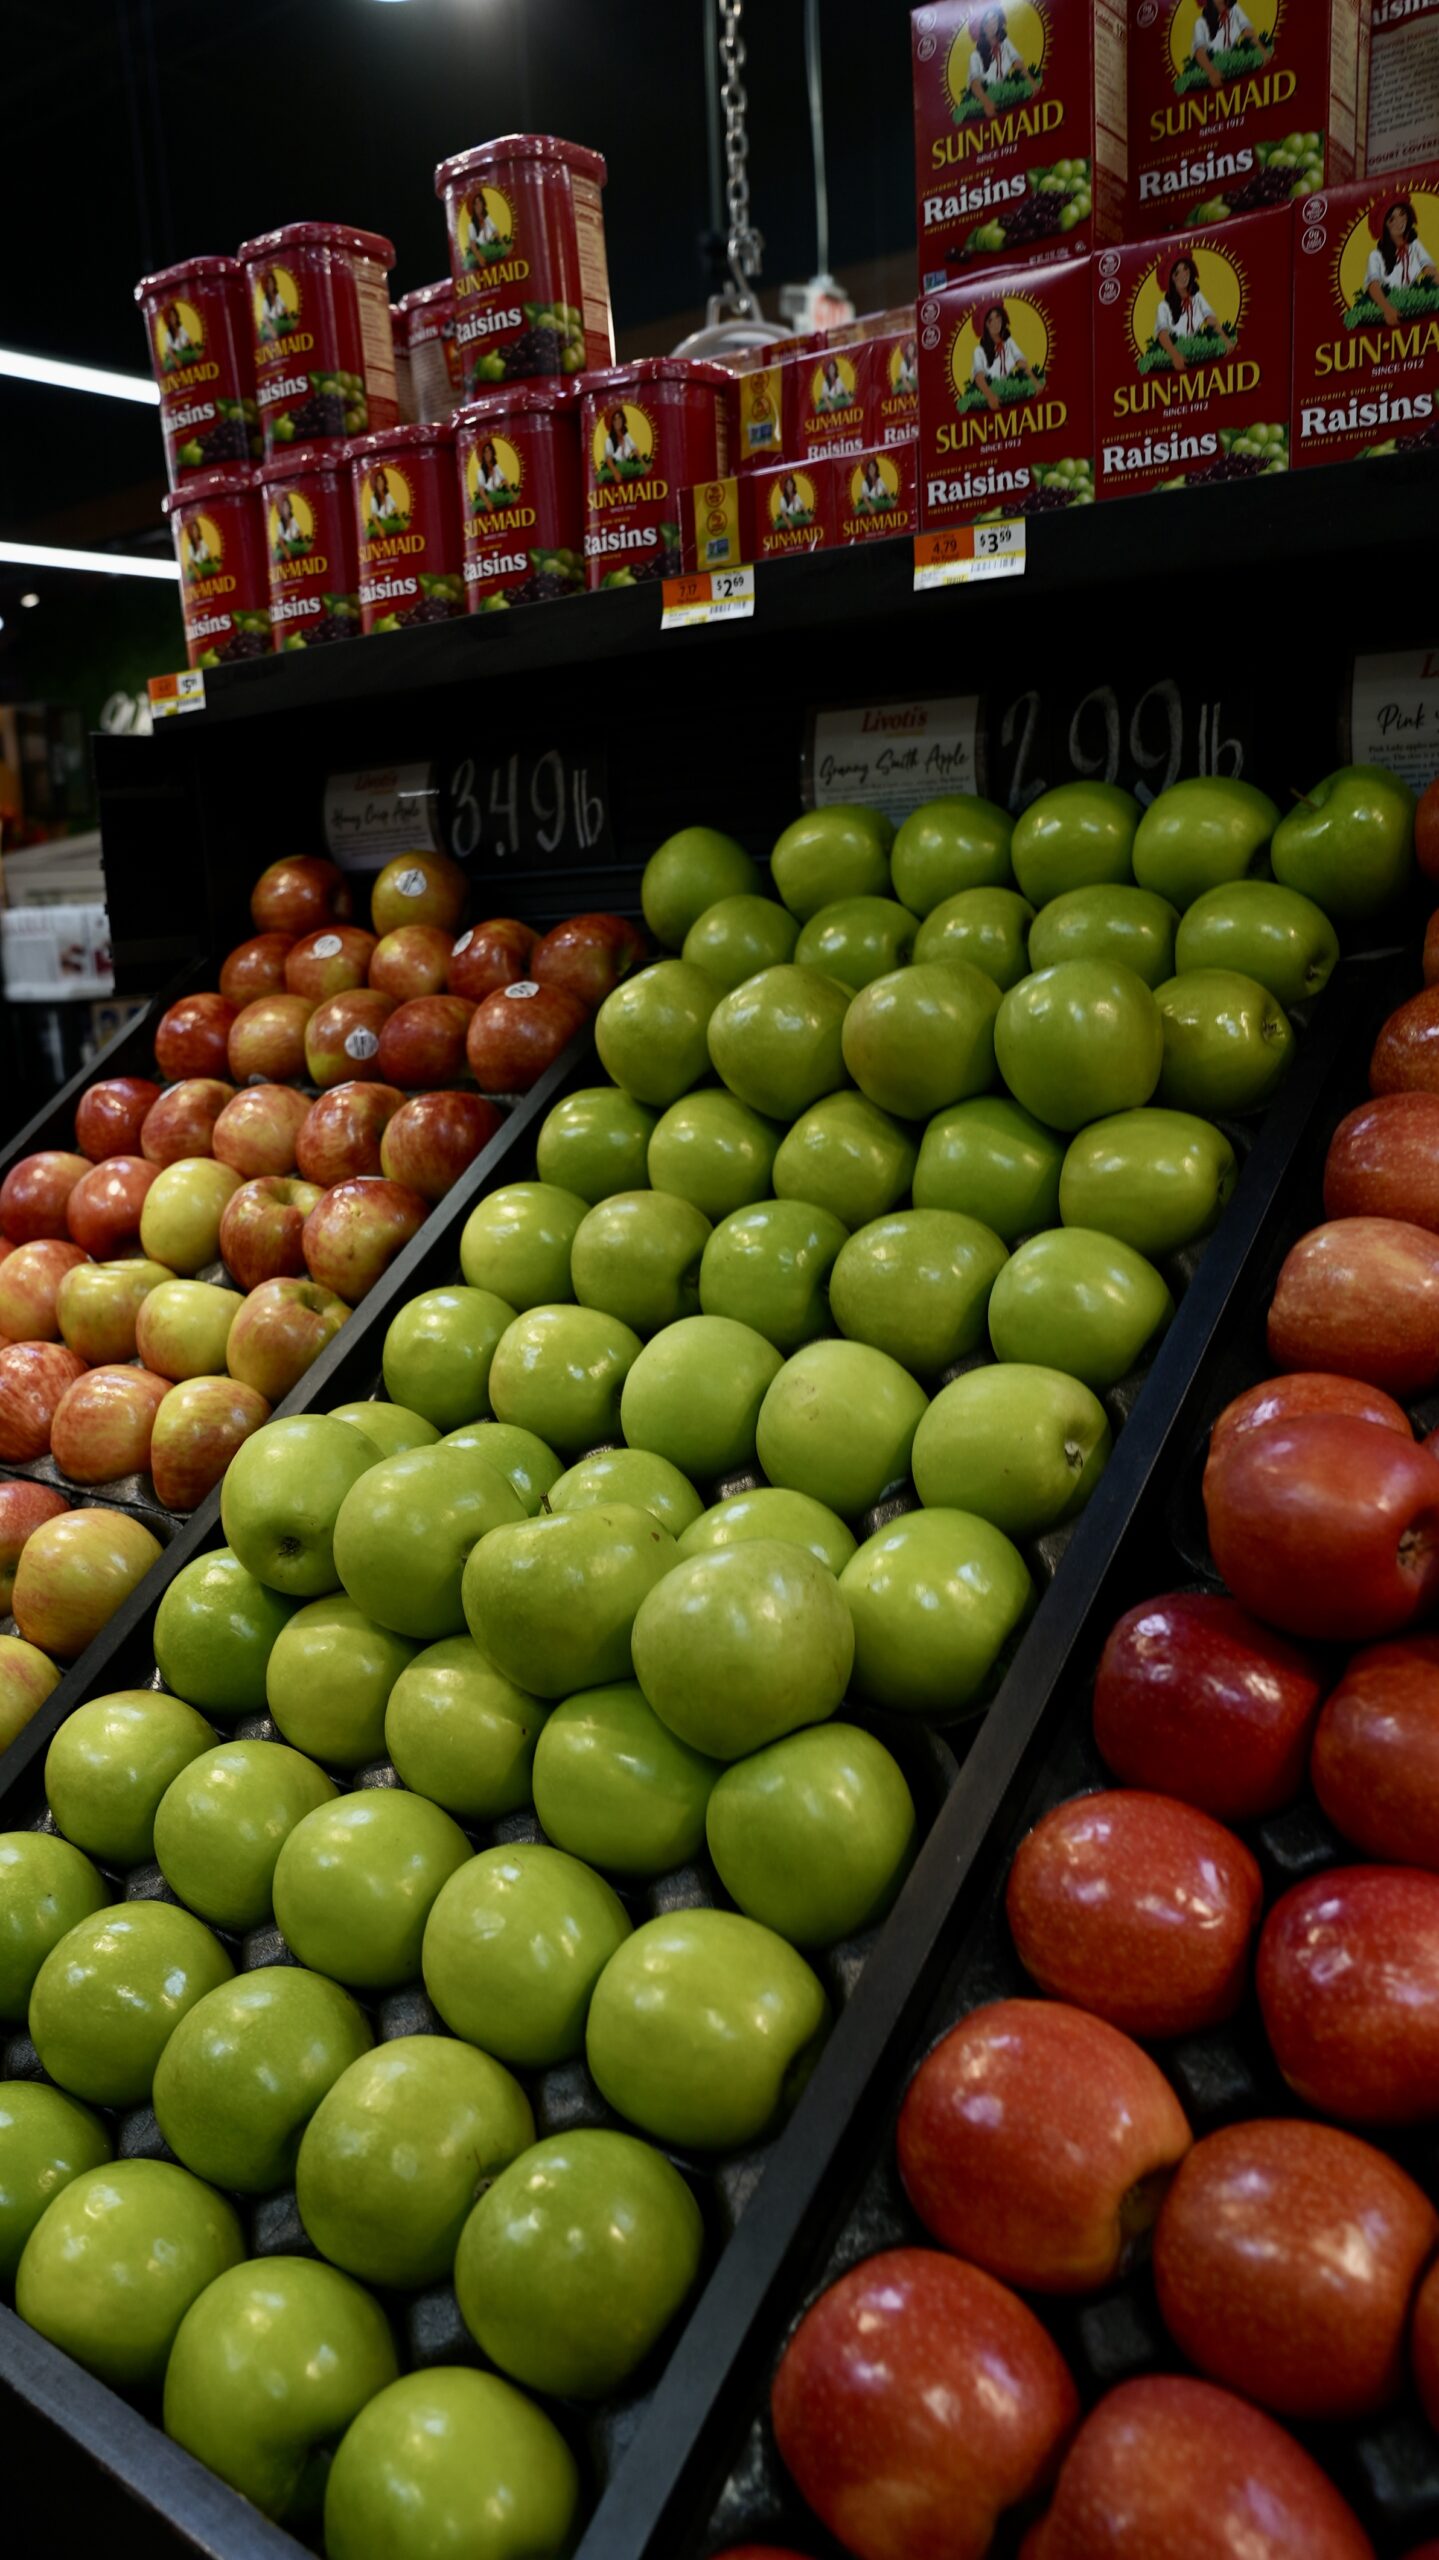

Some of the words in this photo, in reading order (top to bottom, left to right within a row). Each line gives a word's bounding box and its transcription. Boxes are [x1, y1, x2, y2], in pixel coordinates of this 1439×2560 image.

[1150, 69, 1297, 142] SUN·MAID
[932, 99, 1064, 170] SUN·MAID
[1139, 148, 1254, 201] Raisins
[923, 174, 1026, 226] Raisins
[1371, 363, 1400, 378] SINCE
[1403, 357, 1424, 373] 1912
[1113, 360, 1260, 418] SUN·MAID
[804, 406, 864, 435] SUN·MAID
[935, 400, 1067, 455] SUN·MAID
[1163, 404, 1187, 418] SINCE
[1300, 391, 1433, 438] Raisins
[1102, 431, 1217, 475] Raisins
[587, 479, 669, 512] SUN·MAID
[927, 466, 1030, 507] Raisins
[763, 526, 824, 552] SUN·MAID
[843, 510, 908, 538] SUN·MAID
[933, 539, 957, 554] 4.79
[862, 704, 928, 733] Livoti's
[1377, 703, 1425, 736] Pink
[820, 755, 868, 786] Granny
[876, 748, 918, 776] Smith
[925, 741, 970, 775] Apple
[449, 749, 566, 859] 3.49
[573, 768, 605, 850] lb
